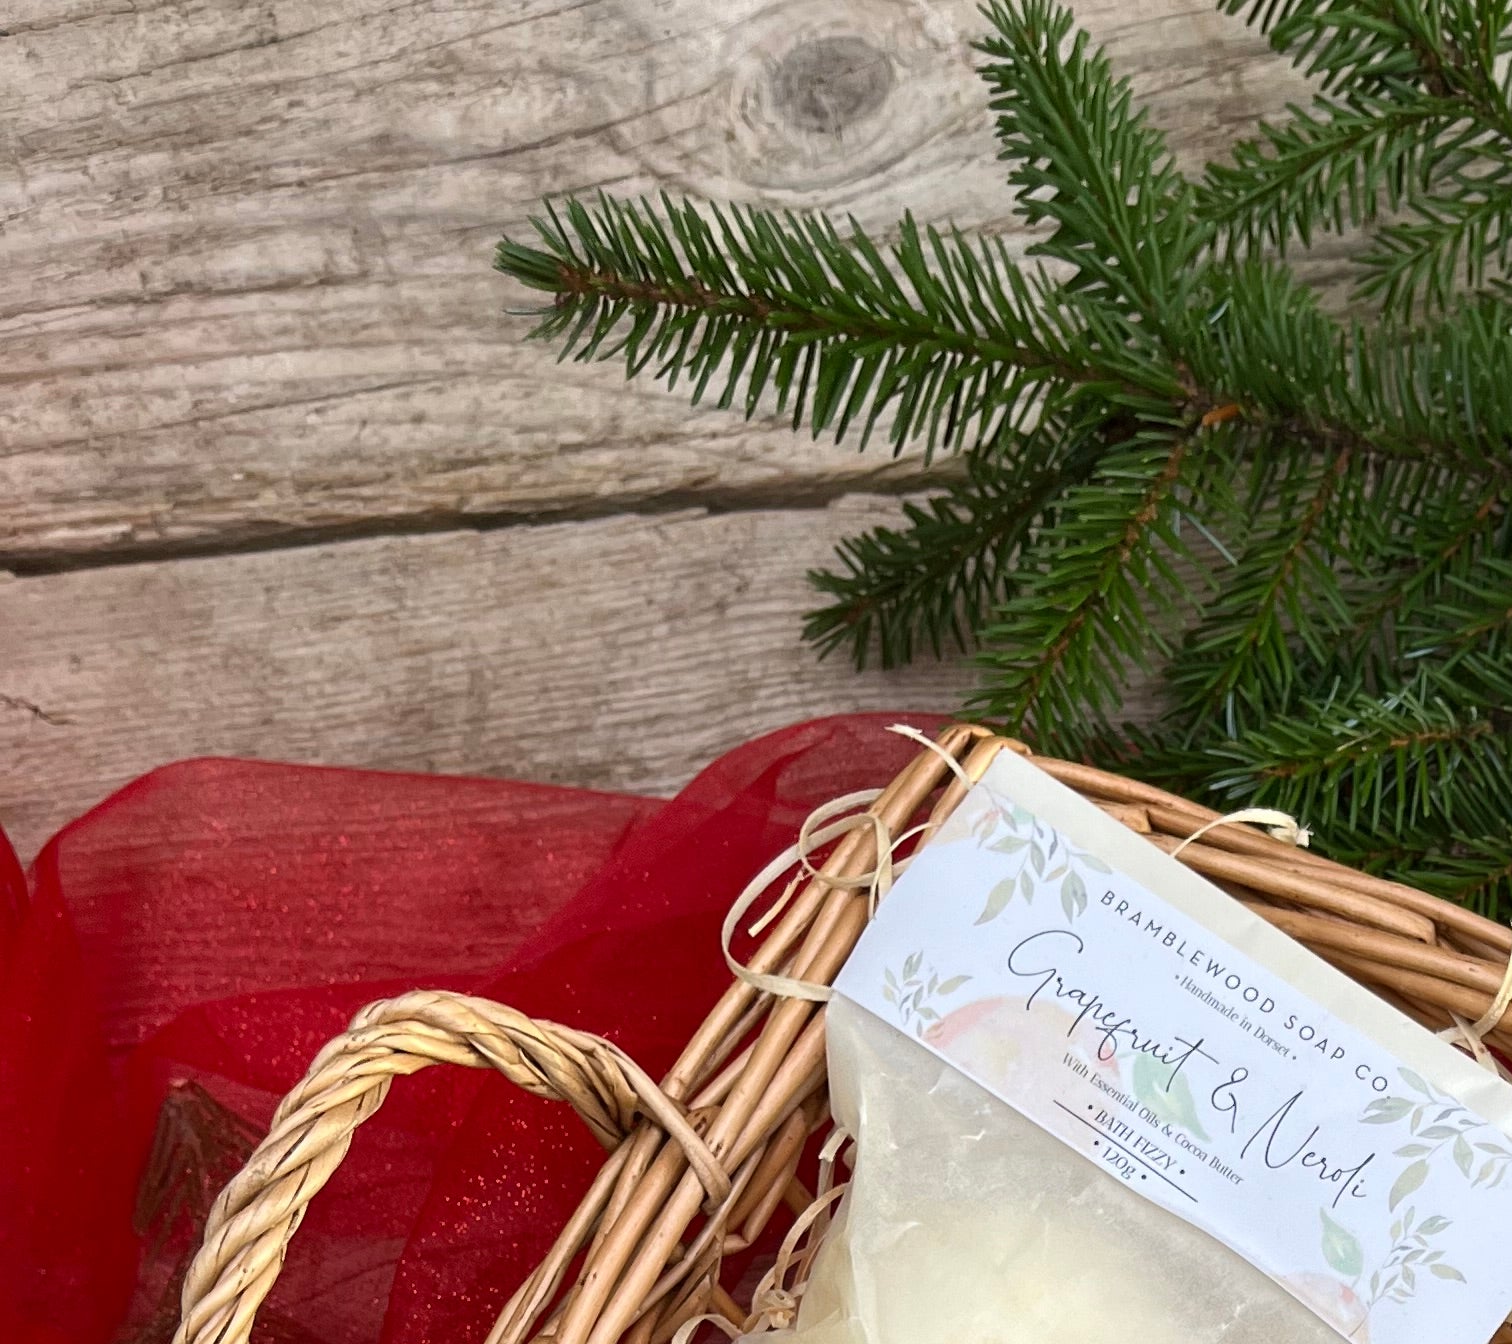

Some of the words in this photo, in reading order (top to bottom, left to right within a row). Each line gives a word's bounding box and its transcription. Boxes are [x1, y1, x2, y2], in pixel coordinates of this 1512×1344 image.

[1100, 890, 1275, 1014] BRAMBLEWOOD
[1284, 1015, 1346, 1061] SOAP
[1354, 1064, 1392, 1100] CO.
[1179, 975, 1240, 1024] Handmade
[1240, 1017, 1253, 1032] in
[1253, 1024, 1290, 1058] Dorset
[1008, 930, 1220, 1093] Grapefruit
[1211, 1067, 1249, 1134] &
[1240, 1090, 1376, 1209] Neroli
[1063, 1052, 1089, 1080] With
[1089, 1073, 1139, 1113] Essential
[1138, 1106, 1161, 1129] Oils
[1161, 1123, 1174, 1138] &
[1174, 1133, 1208, 1162] Cocoa
[1209, 1155, 1244, 1186] Butter
[1094, 1109, 1135, 1143] BATH
[1133, 1135, 1178, 1171] FIZZY
[1102, 1146, 1137, 1181] 120g
